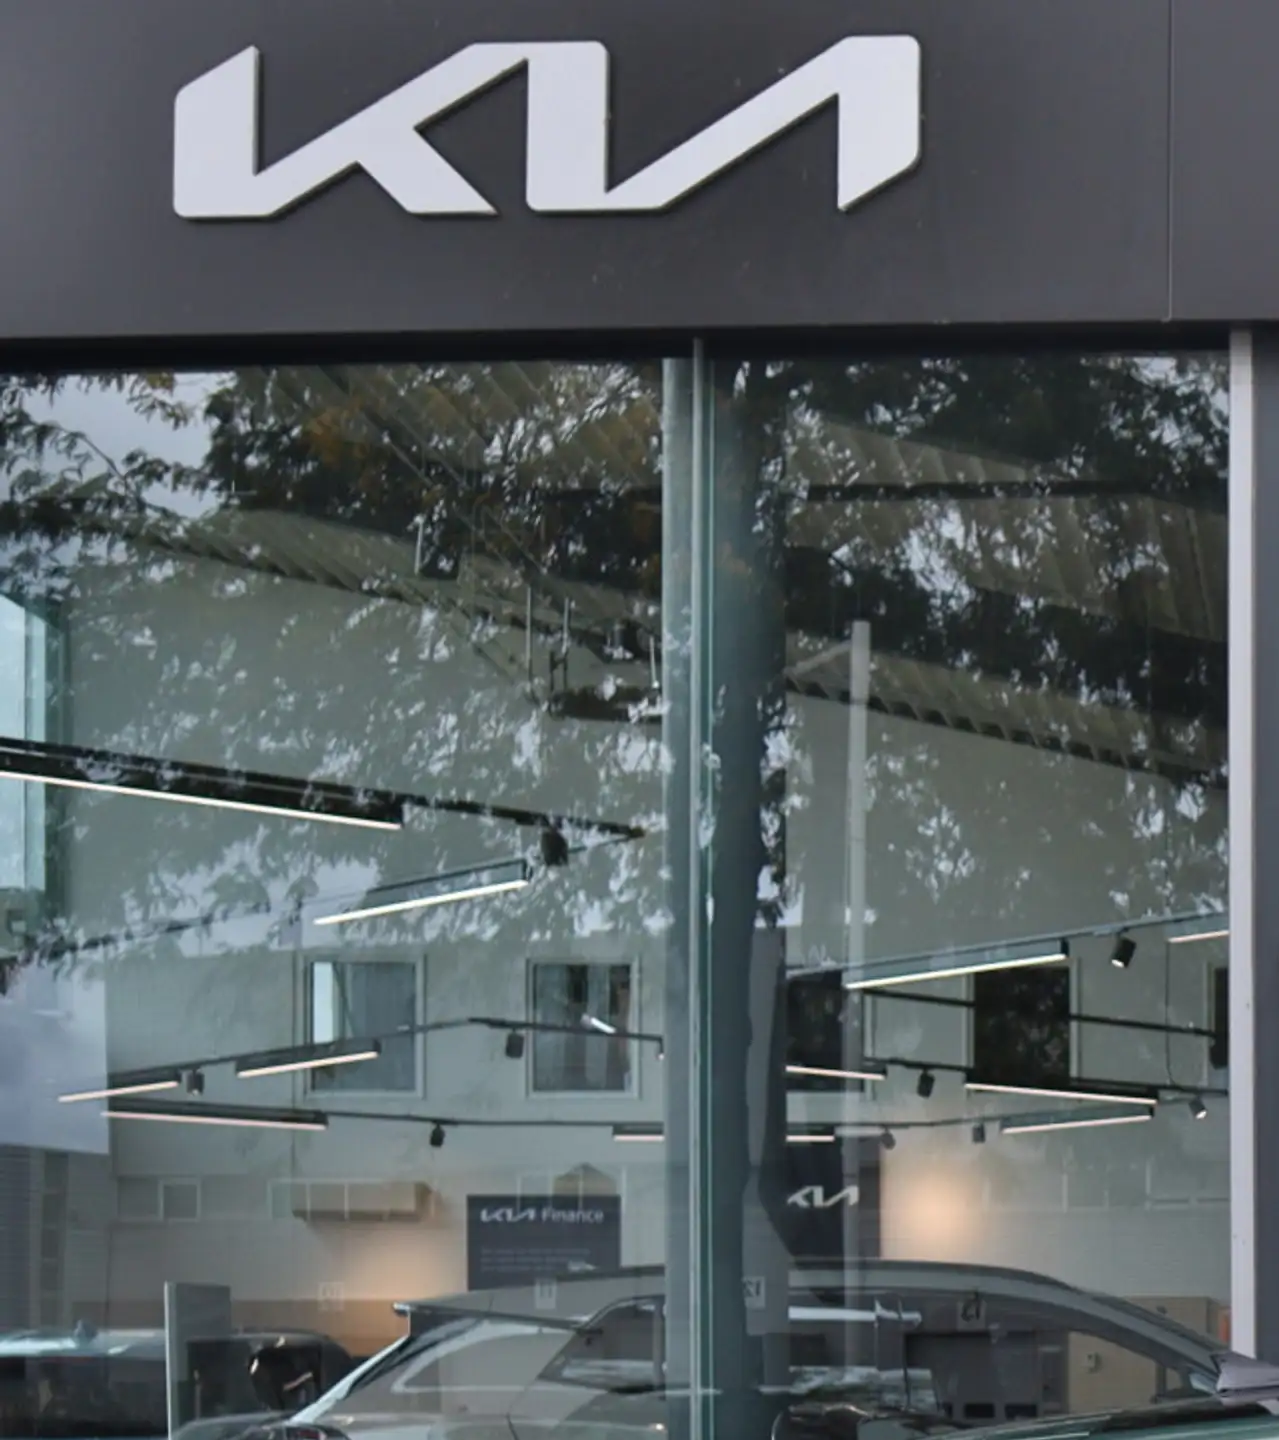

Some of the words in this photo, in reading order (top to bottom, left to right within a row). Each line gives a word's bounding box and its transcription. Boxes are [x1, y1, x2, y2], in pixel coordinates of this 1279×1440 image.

[173, 34, 921, 219] KIA
[480, 1207, 536, 1223] KIA
[541, 1206, 605, 1224] Finance
